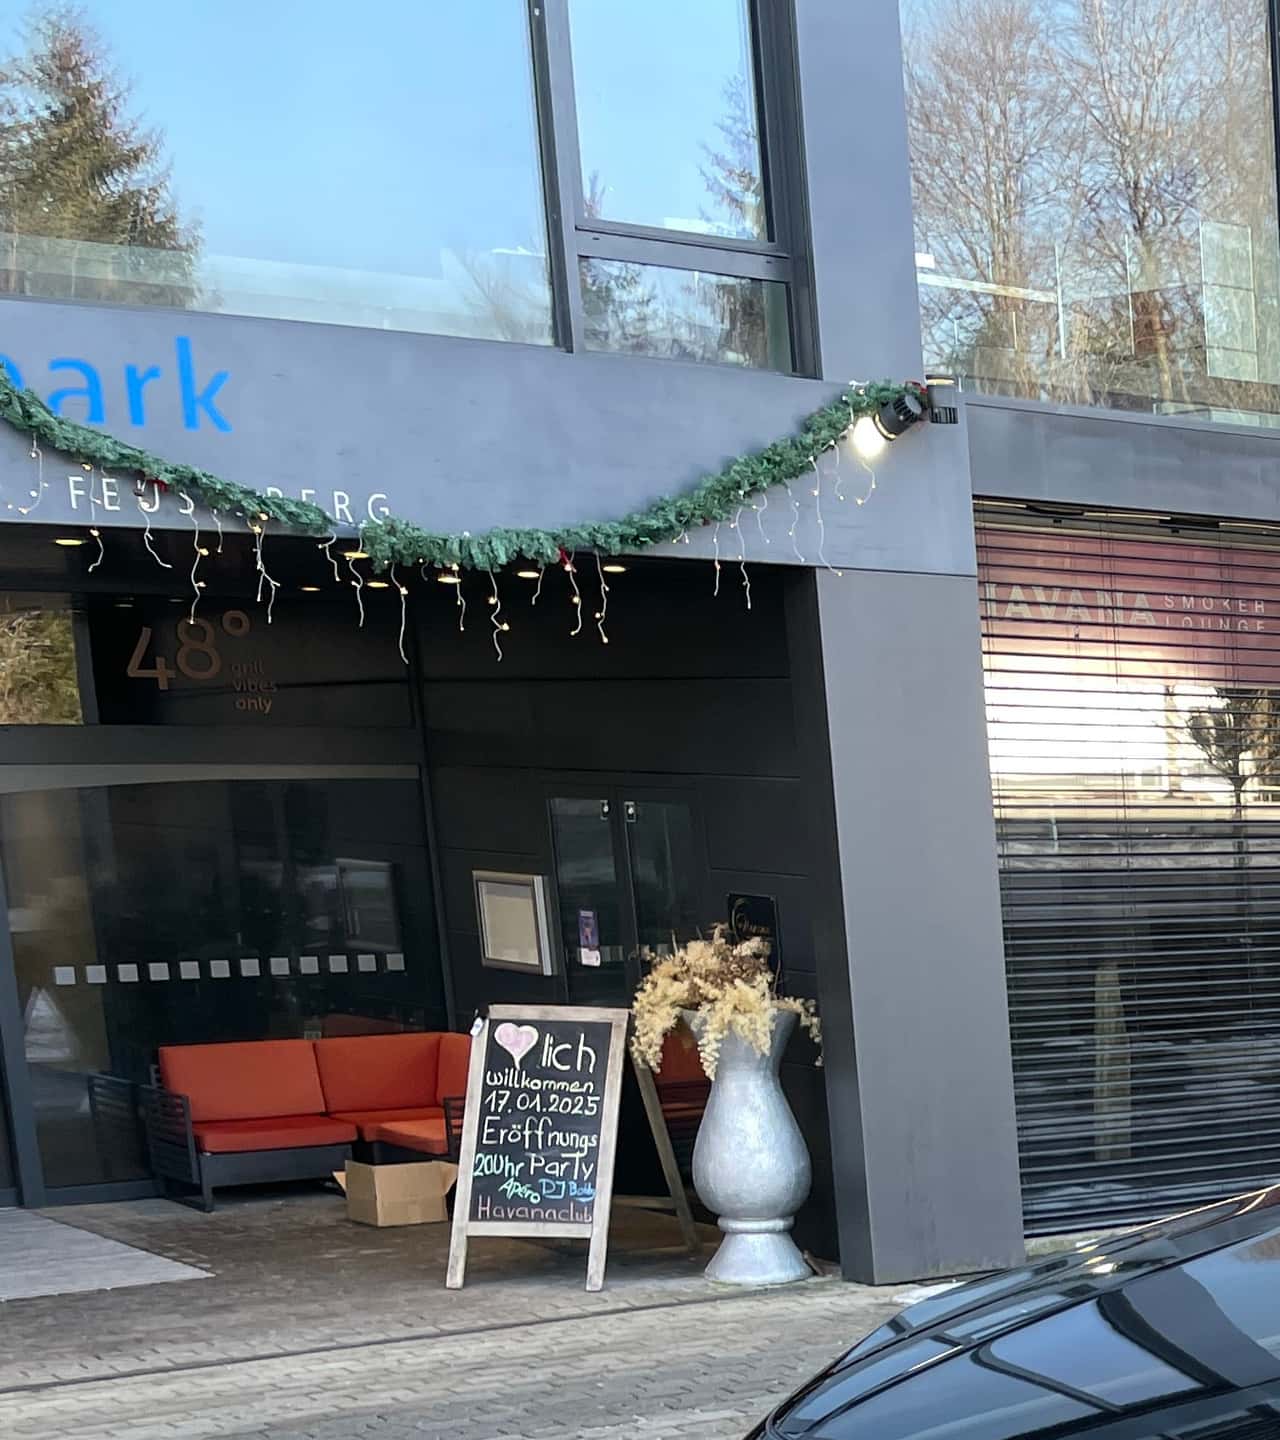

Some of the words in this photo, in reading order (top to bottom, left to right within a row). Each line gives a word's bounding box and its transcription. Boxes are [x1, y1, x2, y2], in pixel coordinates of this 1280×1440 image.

[236, 697, 272, 714] only
[541, 1033, 596, 1074] lich
[486, 1067, 594, 1094] willkommen
[484, 1090, 600, 1116] 17.01.2025
[482, 1115, 598, 1158] Eröffnungs
[477, 1194, 592, 1223] Havanaclub
